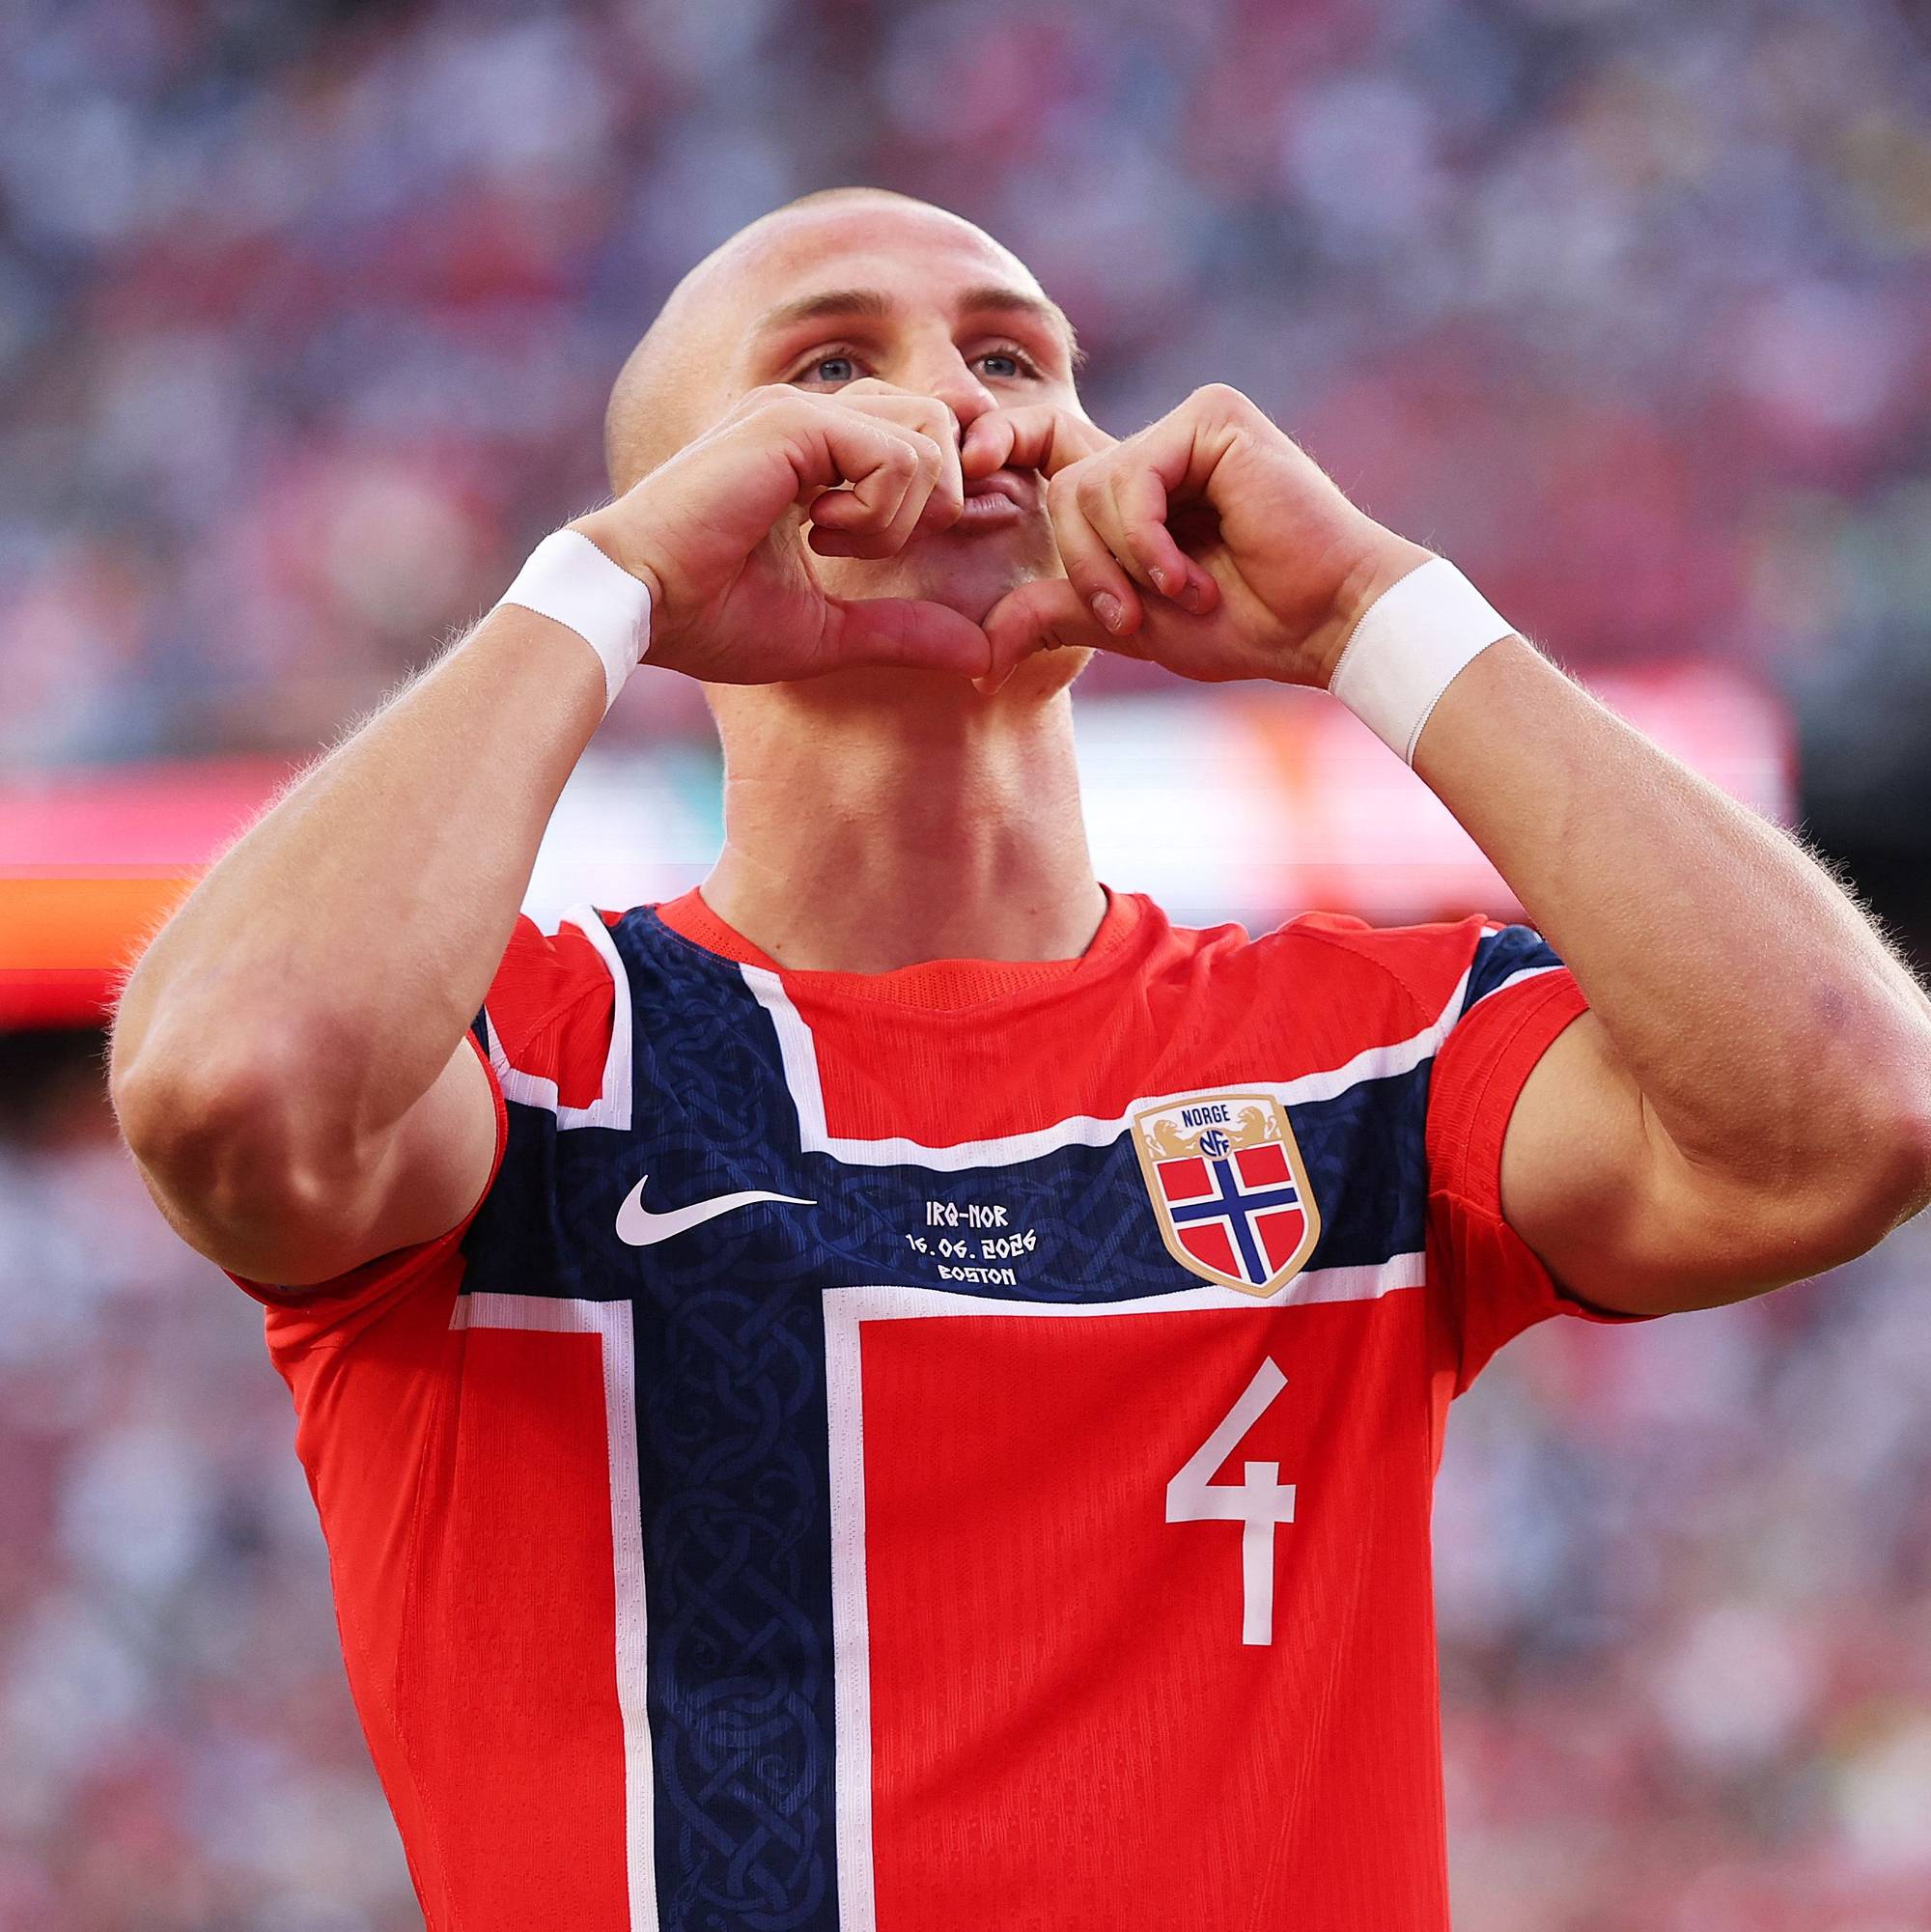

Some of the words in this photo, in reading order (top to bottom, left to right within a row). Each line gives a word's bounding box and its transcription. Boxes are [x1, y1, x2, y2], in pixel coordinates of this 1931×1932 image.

[1182, 1105, 1230, 1127] NORGE
[927, 1201, 1009, 1228] IRQ-NOR
[938, 1264, 1018, 1285] BOSTON
[1165, 1356, 1296, 1645] 4
